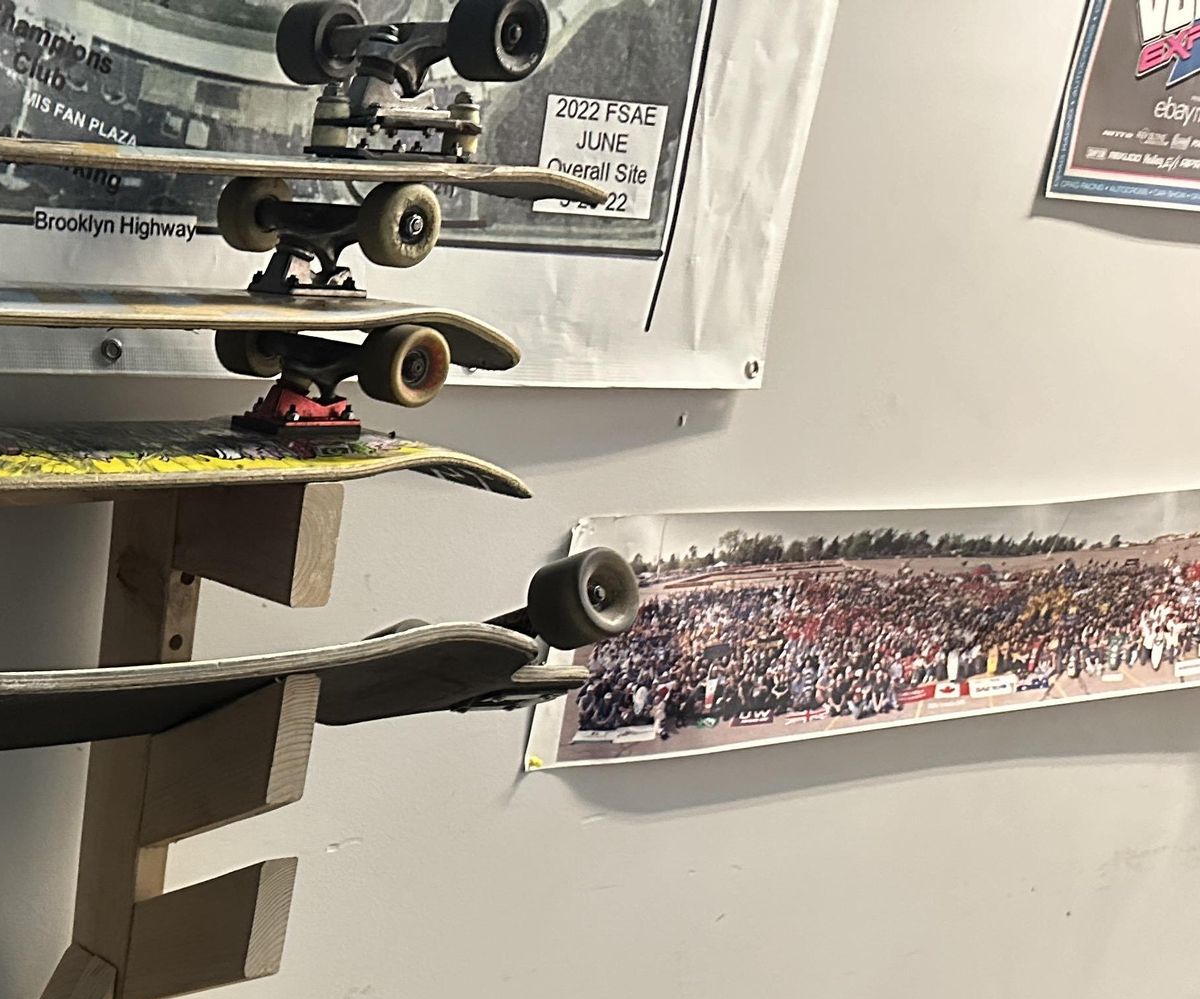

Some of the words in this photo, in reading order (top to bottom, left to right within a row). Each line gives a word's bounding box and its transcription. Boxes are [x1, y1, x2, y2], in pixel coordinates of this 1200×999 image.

[12, 51, 66, 92] Club
[23, 91, 51, 113] MIS
[53, 102, 87, 129] FAN
[88, 116, 138, 147] PLAZA
[556, 97, 600, 121] 2022
[605, 102, 657, 127] FSAE
[576, 130, 629, 153] JUNE
[547, 158, 611, 182] Overall
[615, 163, 648, 184] Site
[34, 210, 114, 238] Brooklyn
[120, 215, 196, 243] Highway
